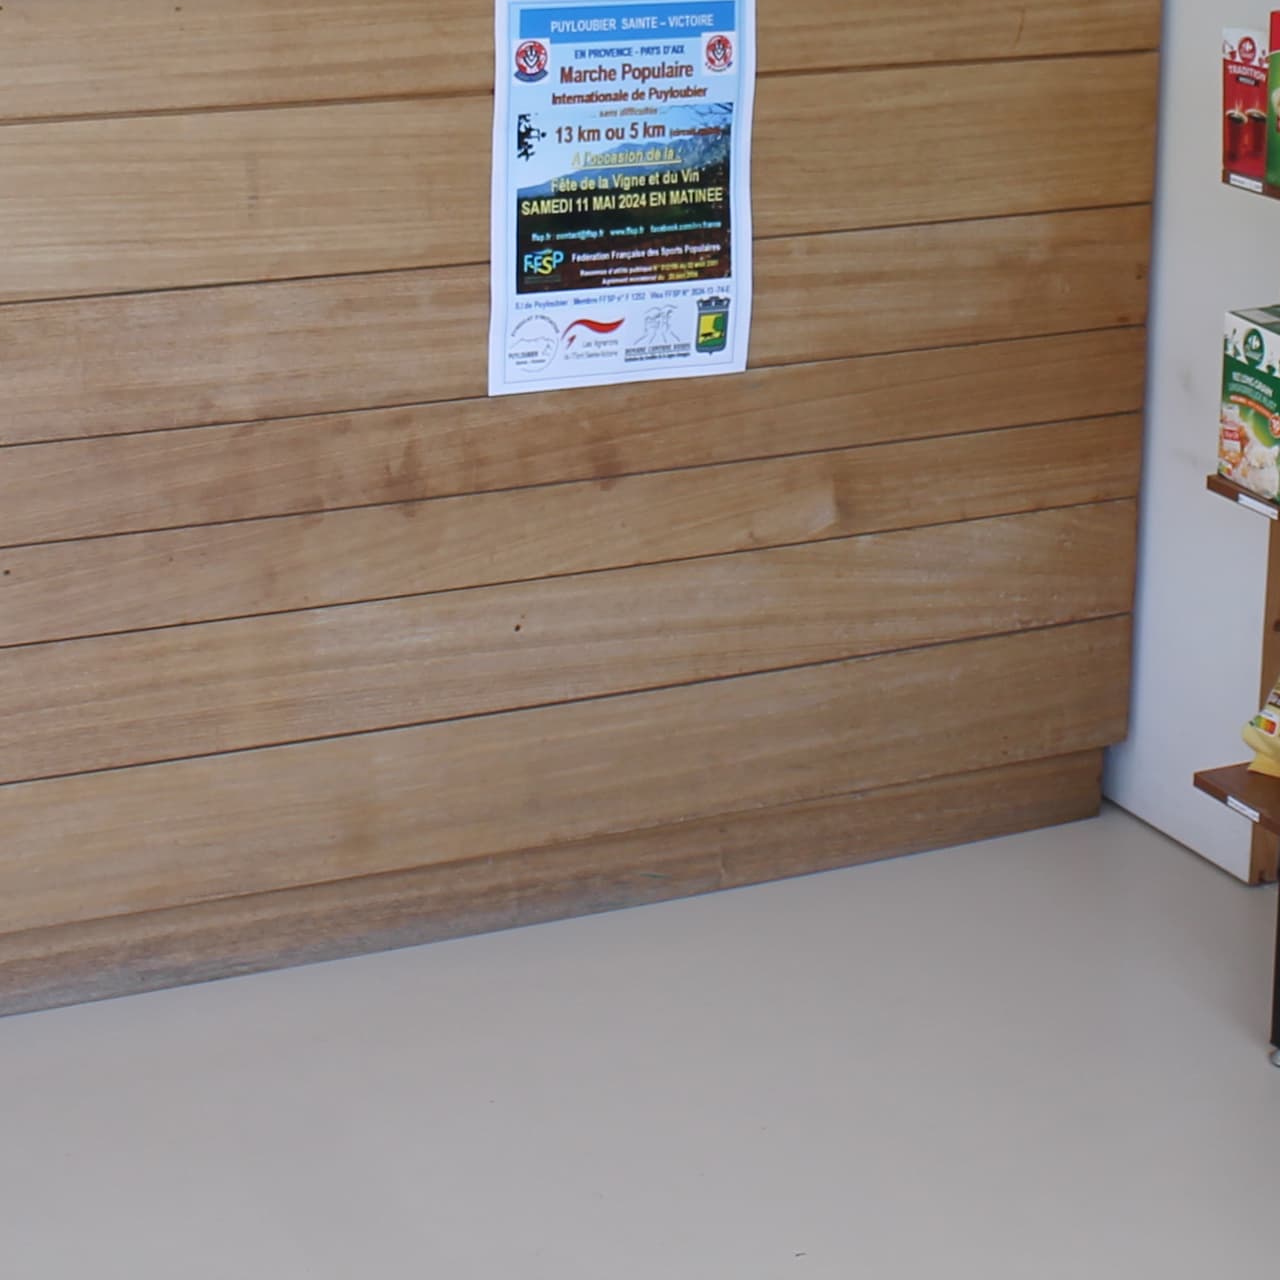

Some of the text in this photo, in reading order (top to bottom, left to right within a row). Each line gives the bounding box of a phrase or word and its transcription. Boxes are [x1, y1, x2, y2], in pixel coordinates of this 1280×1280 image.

[551, 14, 714, 34] PUYLOUBIER SAINTE VICTOIRE
[588, 47, 633, 59] PROVENCE
[560, 62, 694, 84] Marche Populaire
[552, 86, 708, 106] Internationale de Puyloubier
[555, 126, 574, 144] 13
[577, 125, 601, 143] km
[605, 126, 625, 141] ou
[630, 122, 639, 140] 5
[643, 121, 666, 138] km
[550, 176, 577, 193] Fête
[580, 175, 596, 191] de
[612, 171, 646, 191] Vigne
[648, 171, 660, 186] et
[662, 170, 677, 185] du
[680, 169, 700, 184] Vin
[521, 198, 573, 216] SAMEDI
[576, 197, 589, 213] 11
[592, 195, 616, 212] MAI
[618, 192, 647, 209] 2024
[650, 191, 666, 206] EN
